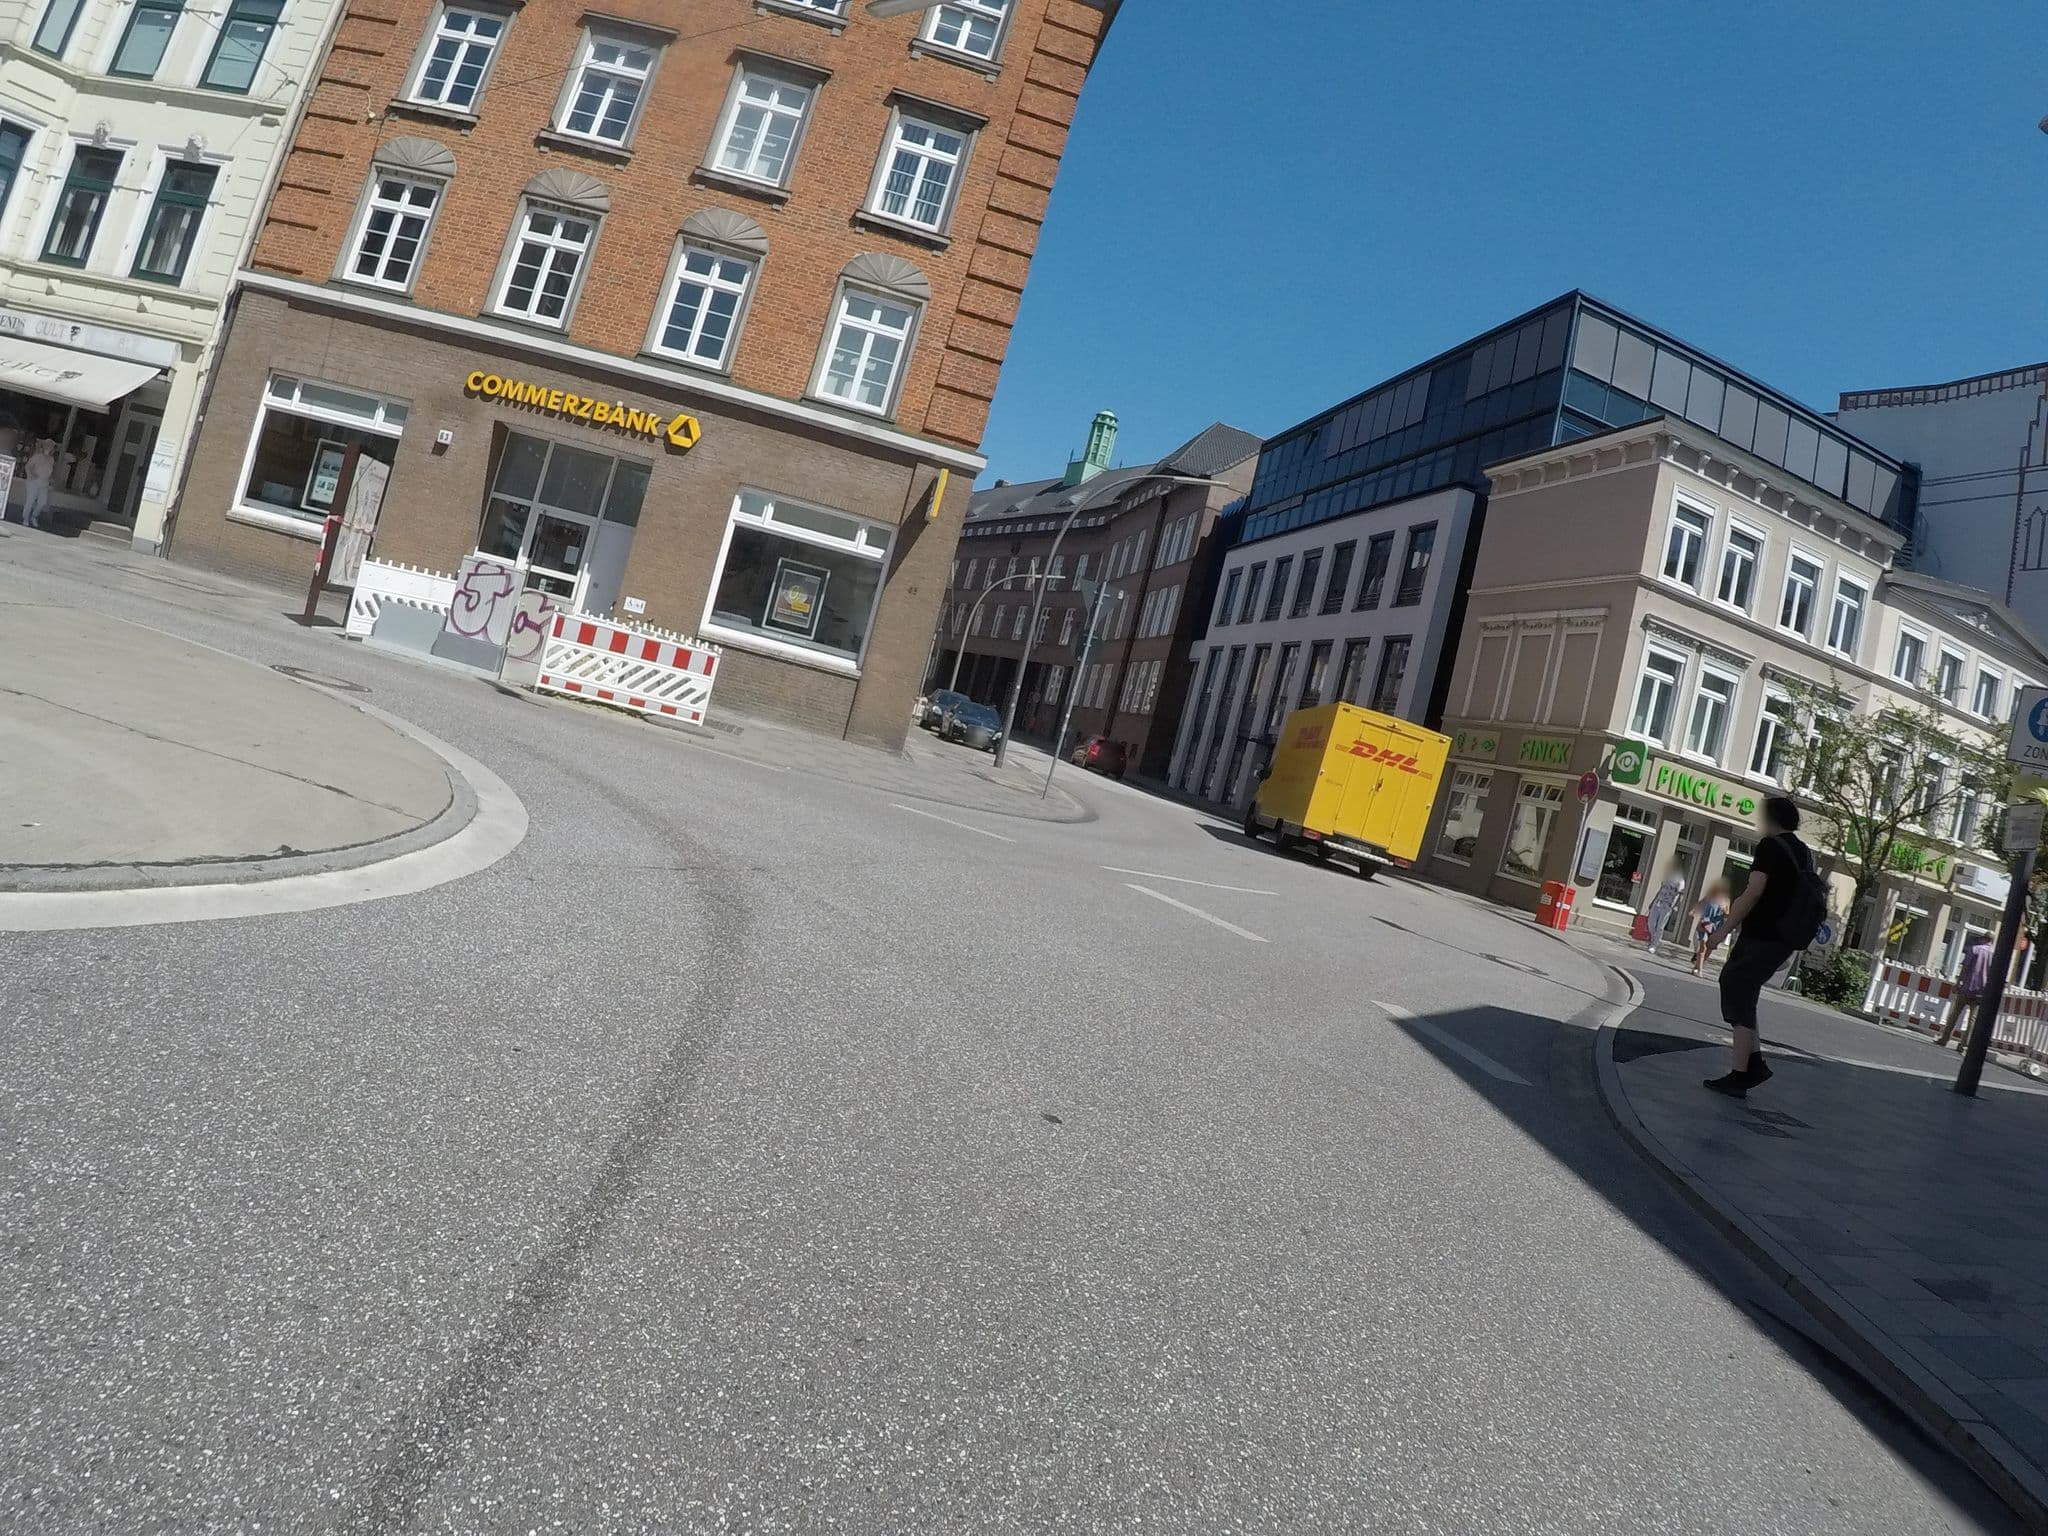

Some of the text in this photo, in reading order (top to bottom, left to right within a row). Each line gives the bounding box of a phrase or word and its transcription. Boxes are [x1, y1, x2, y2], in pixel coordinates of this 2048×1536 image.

[466, 370, 662, 436] COMMERZBANK
[1348, 738, 1419, 775] DHL
[1520, 740, 1571, 764] FINCK
[1656, 765, 1719, 809] FINCK
